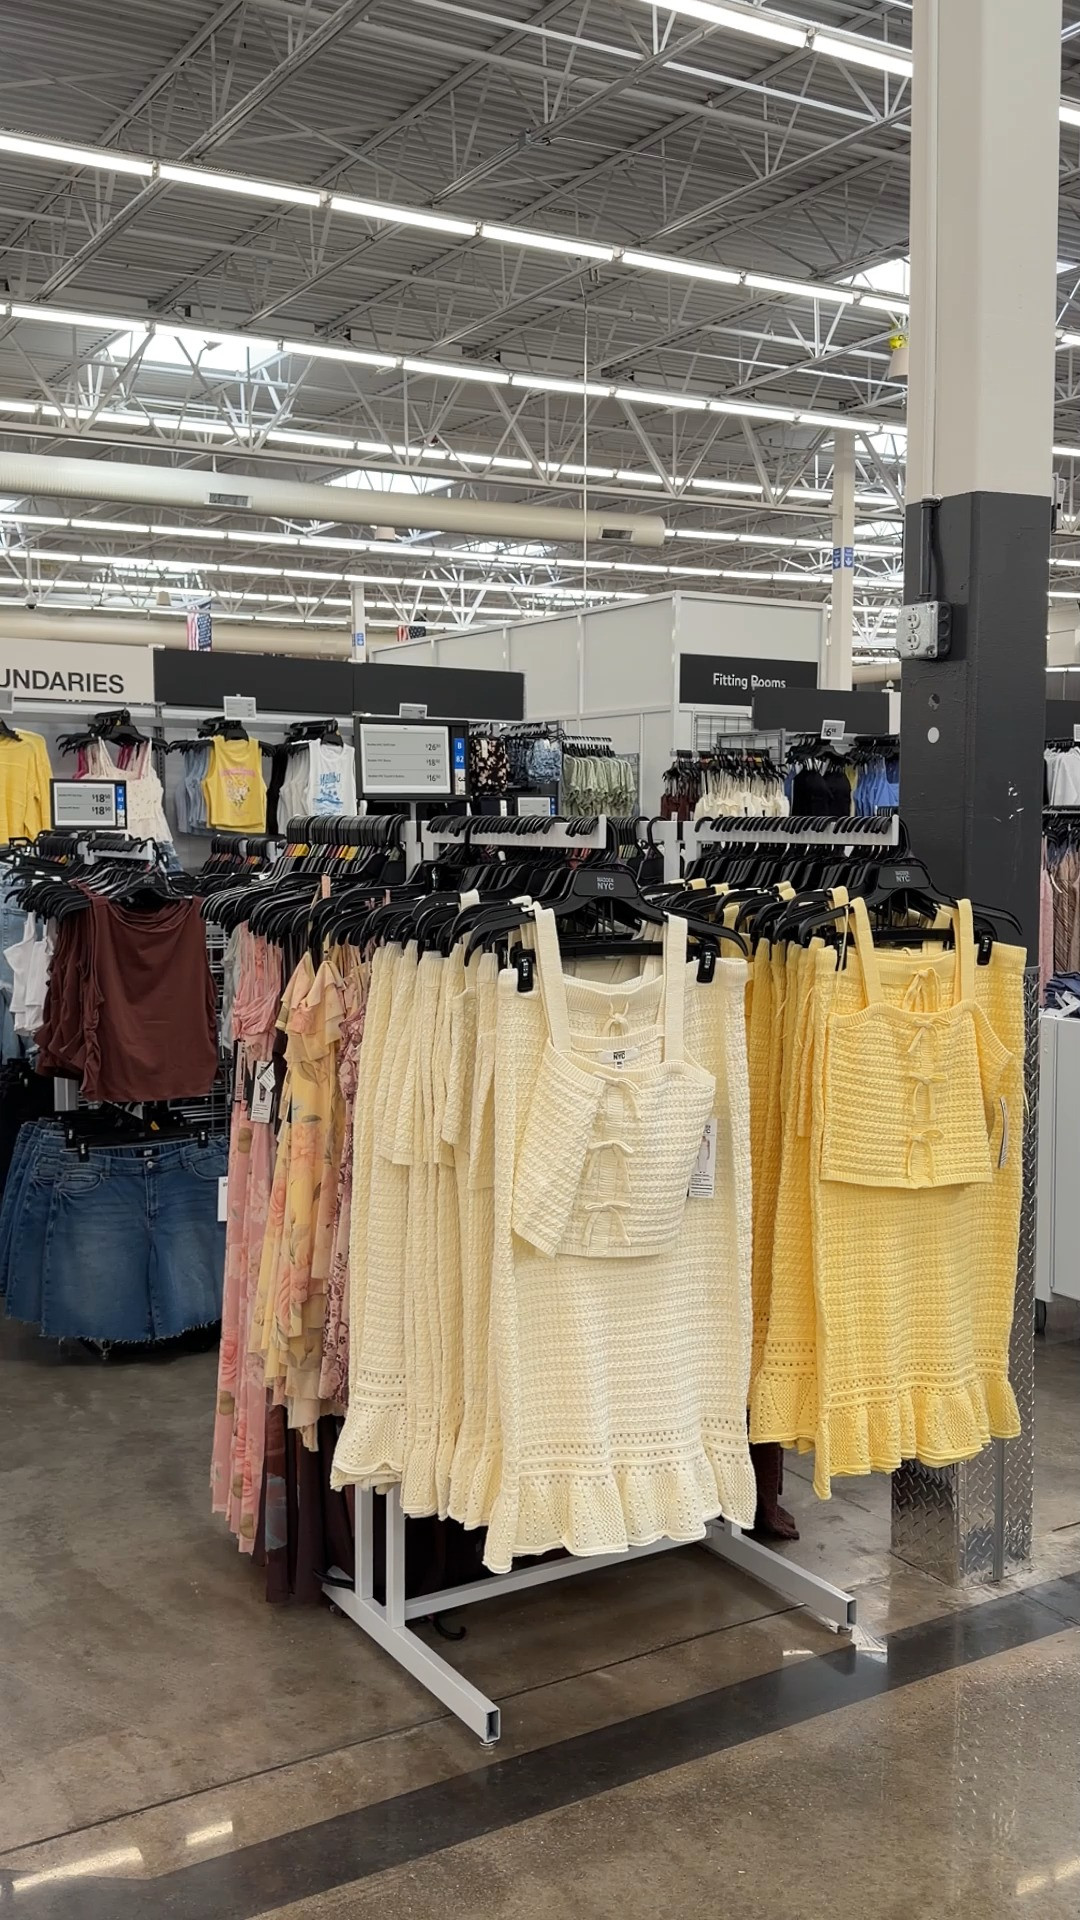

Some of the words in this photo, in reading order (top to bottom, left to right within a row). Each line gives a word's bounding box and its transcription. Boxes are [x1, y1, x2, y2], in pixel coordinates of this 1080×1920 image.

[713, 672, 748, 690] Fitting
[750, 675, 786, 688] Rooms
[597, 882, 614, 890] NYC
[613, 1052, 625, 1060] NYC
